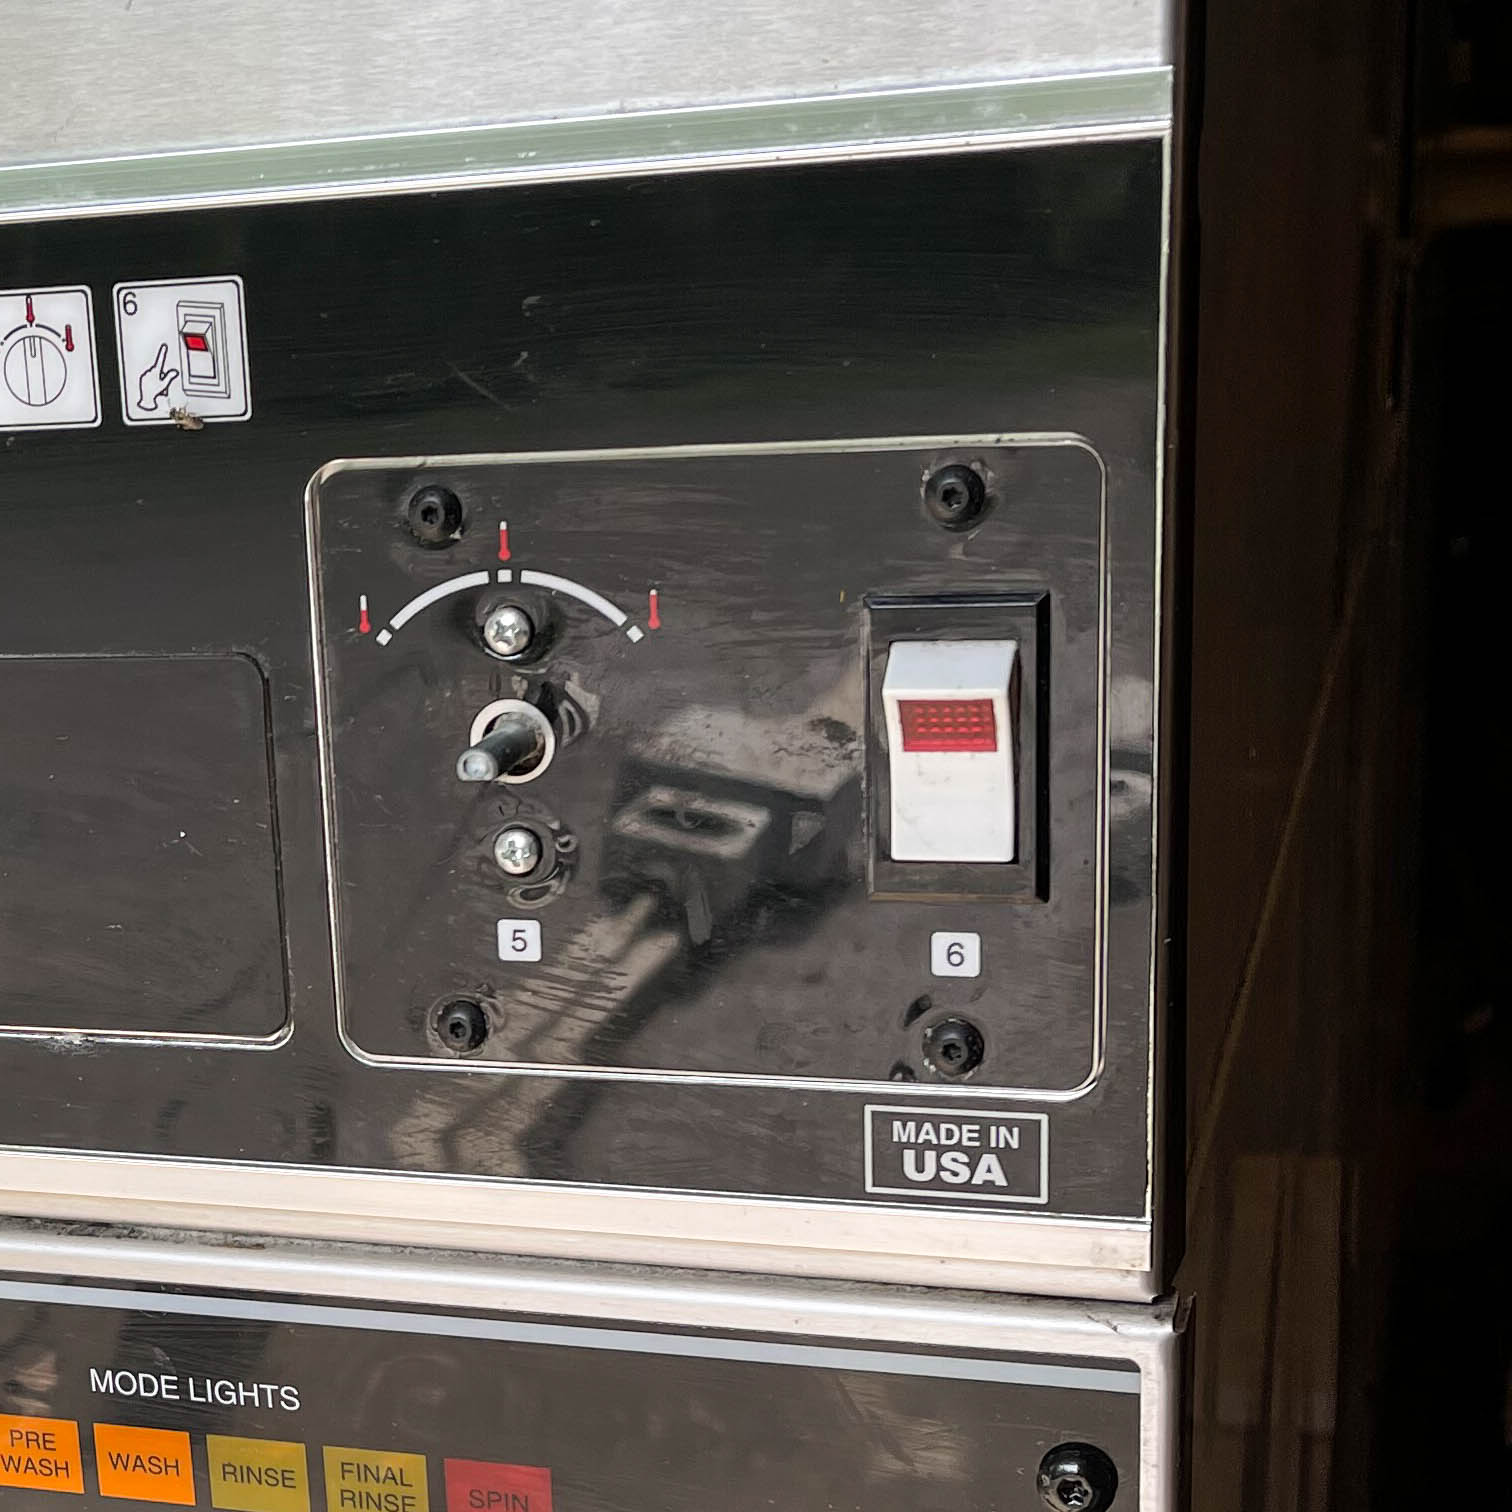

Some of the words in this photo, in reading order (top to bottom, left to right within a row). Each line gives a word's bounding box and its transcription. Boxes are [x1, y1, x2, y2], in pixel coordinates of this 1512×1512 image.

[122, 292, 138, 315] 6
[510, 930, 527, 952] 5
[946, 943, 965, 967] 6
[892, 1121, 980, 1147] MADE
[990, 1126, 1019, 1149] IN
[902, 1150, 1008, 1186] USA
[90, 1368, 179, 1400] MODE
[190, 1378, 301, 1410] LIGHTS
[10, 1429, 55, 1451] PRE
[1, 1454, 69, 1480] WASH
[108, 1451, 180, 1478] WASH
[222, 1463, 296, 1489] RINSE
[341, 1462, 413, 1488] FINAL
